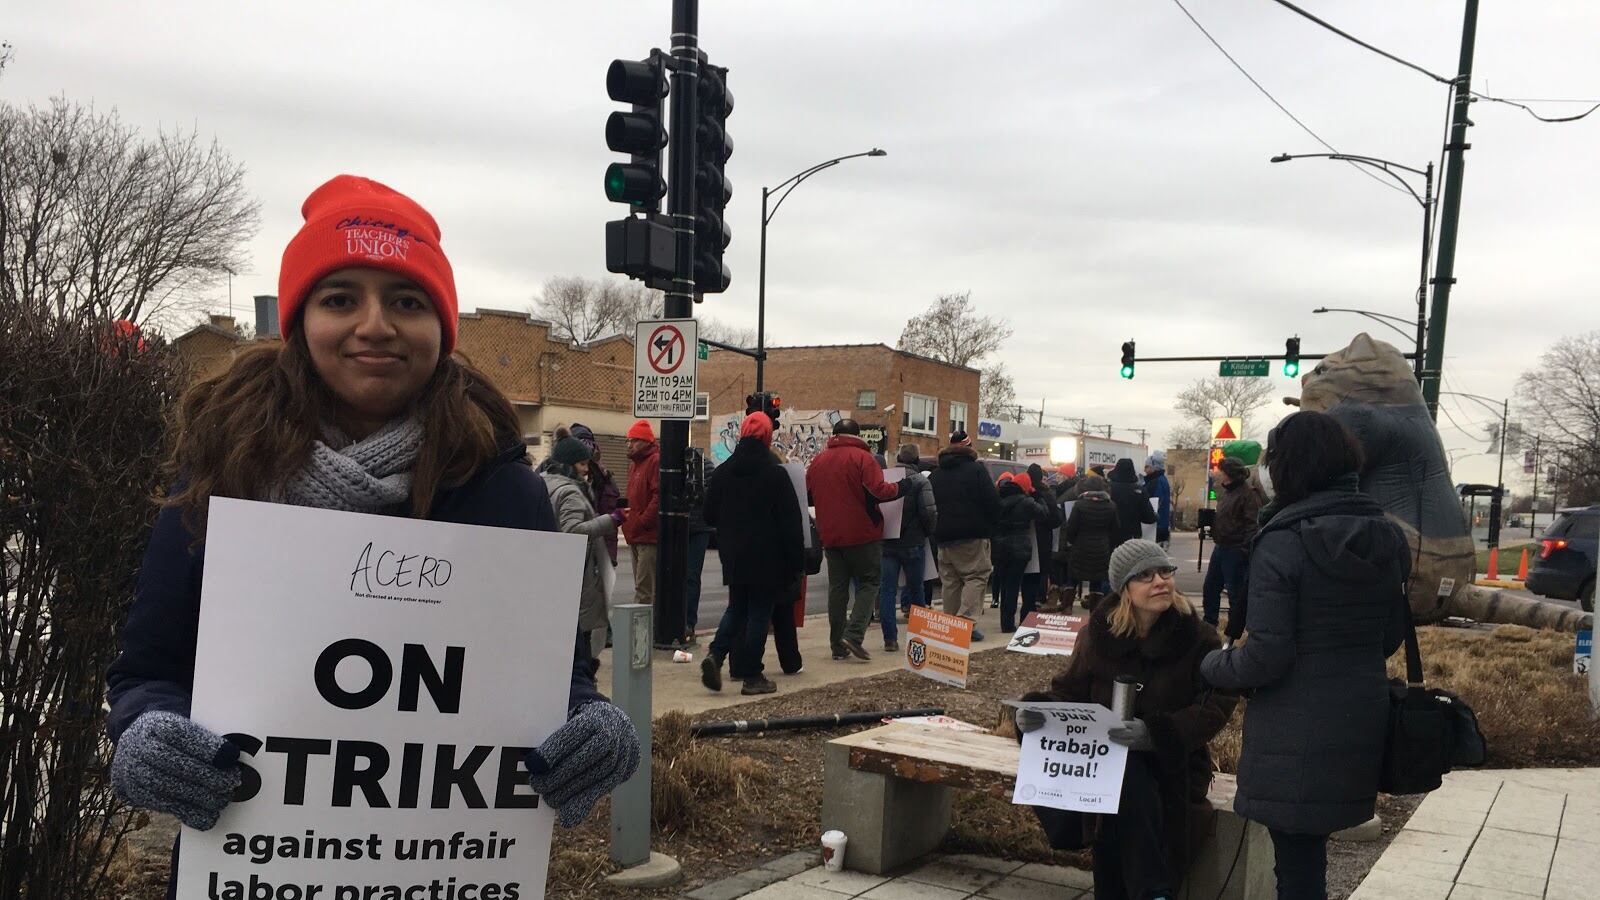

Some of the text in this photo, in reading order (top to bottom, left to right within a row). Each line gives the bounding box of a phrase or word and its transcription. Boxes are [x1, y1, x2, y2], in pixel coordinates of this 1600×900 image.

[345, 228, 410, 250] TEACHERS
[347, 239, 407, 261] UNION
[660, 376, 671, 387] TO
[660, 391, 670, 401] TO
[637, 403, 660, 412] MONDAY
[672, 403, 692, 412] FRIDAY
[350, 541, 452, 592] ACERO
[913, 607, 968, 631] ESCUELA PRIMARIA
[314, 638, 466, 714] ON
[1050, 710, 1097, 722] igual
[1066, 724, 1087, 735] por
[1040, 736, 1110, 759] trabajo
[222, 732, 540, 809] STRIKE
[1043, 757, 1098, 778] igual!
[222, 830, 516, 865] against unfair
[209, 872, 520, 900] labor practices
